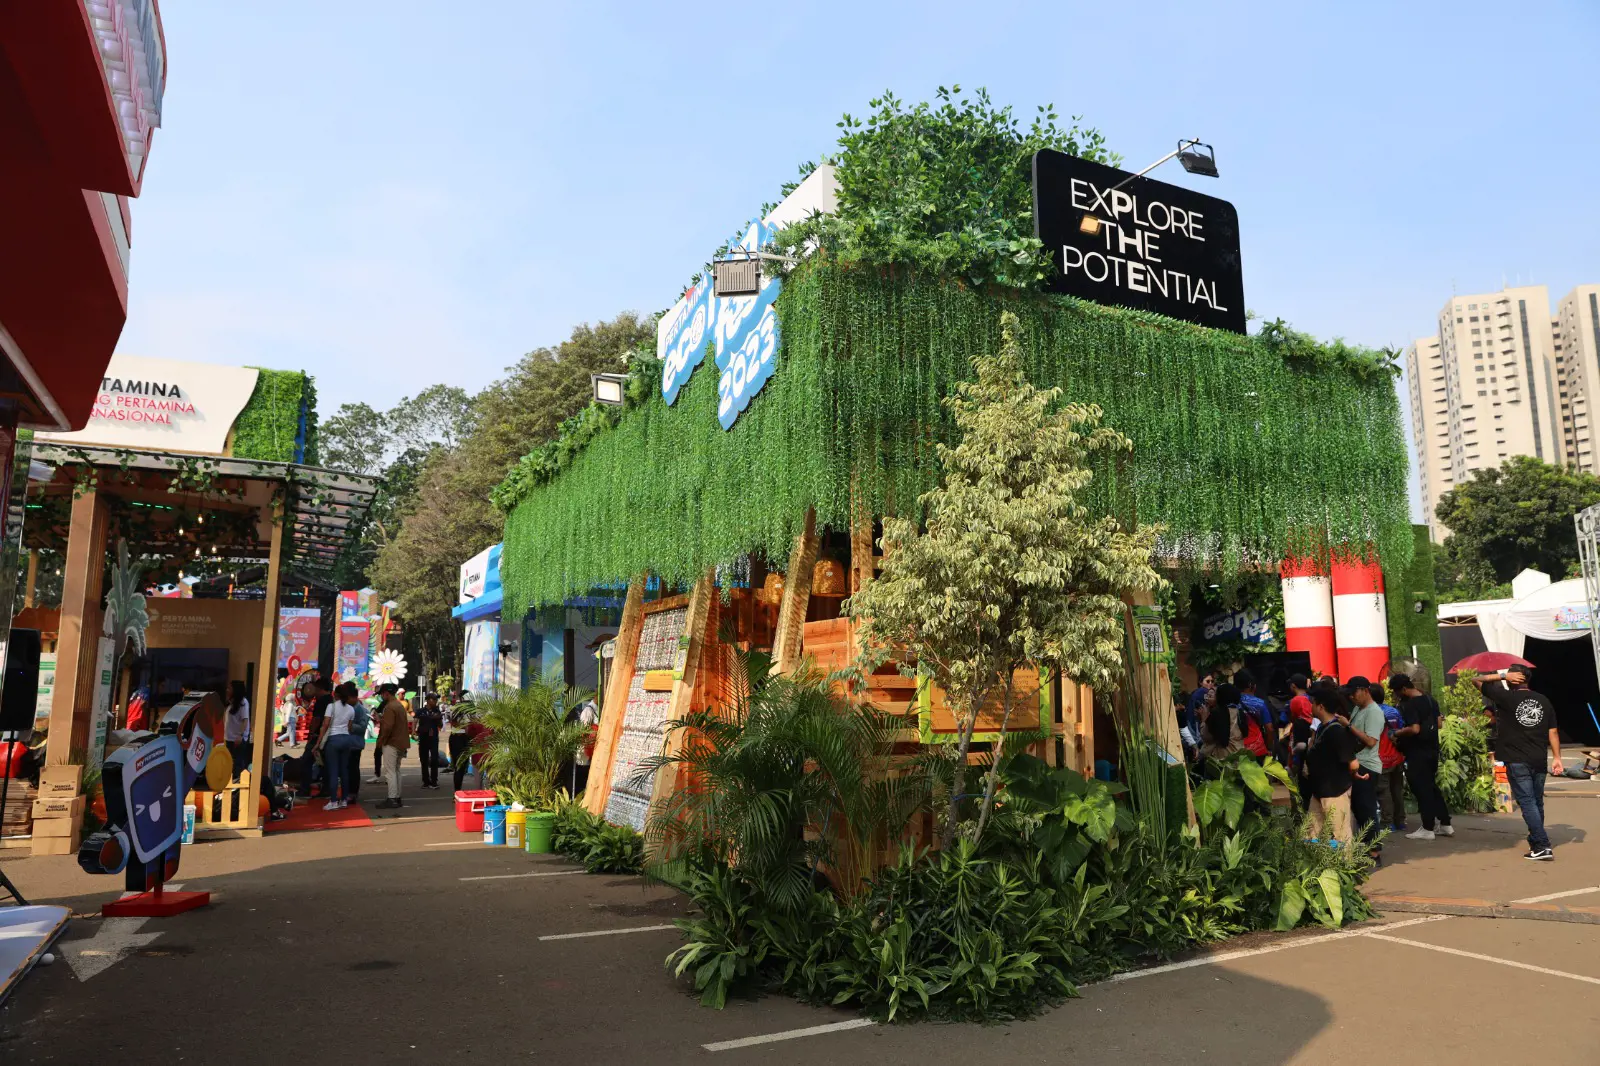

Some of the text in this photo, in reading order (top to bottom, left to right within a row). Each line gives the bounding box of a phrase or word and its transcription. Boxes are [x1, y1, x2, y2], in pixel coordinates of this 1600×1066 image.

[1070, 177, 1206, 242] EXPLORE
[1097, 219, 1162, 263] THE
[1062, 244, 1228, 312] POTENTIAL
[662, 304, 706, 393] eco
[718, 311, 775, 418] 2023
[101, 377, 181, 398] TAMINA
[116, 395, 196, 415] PERTAMINA
[89, 408, 172, 424] RNASIONAL
[162, 615, 212, 623] PERTAMINA
